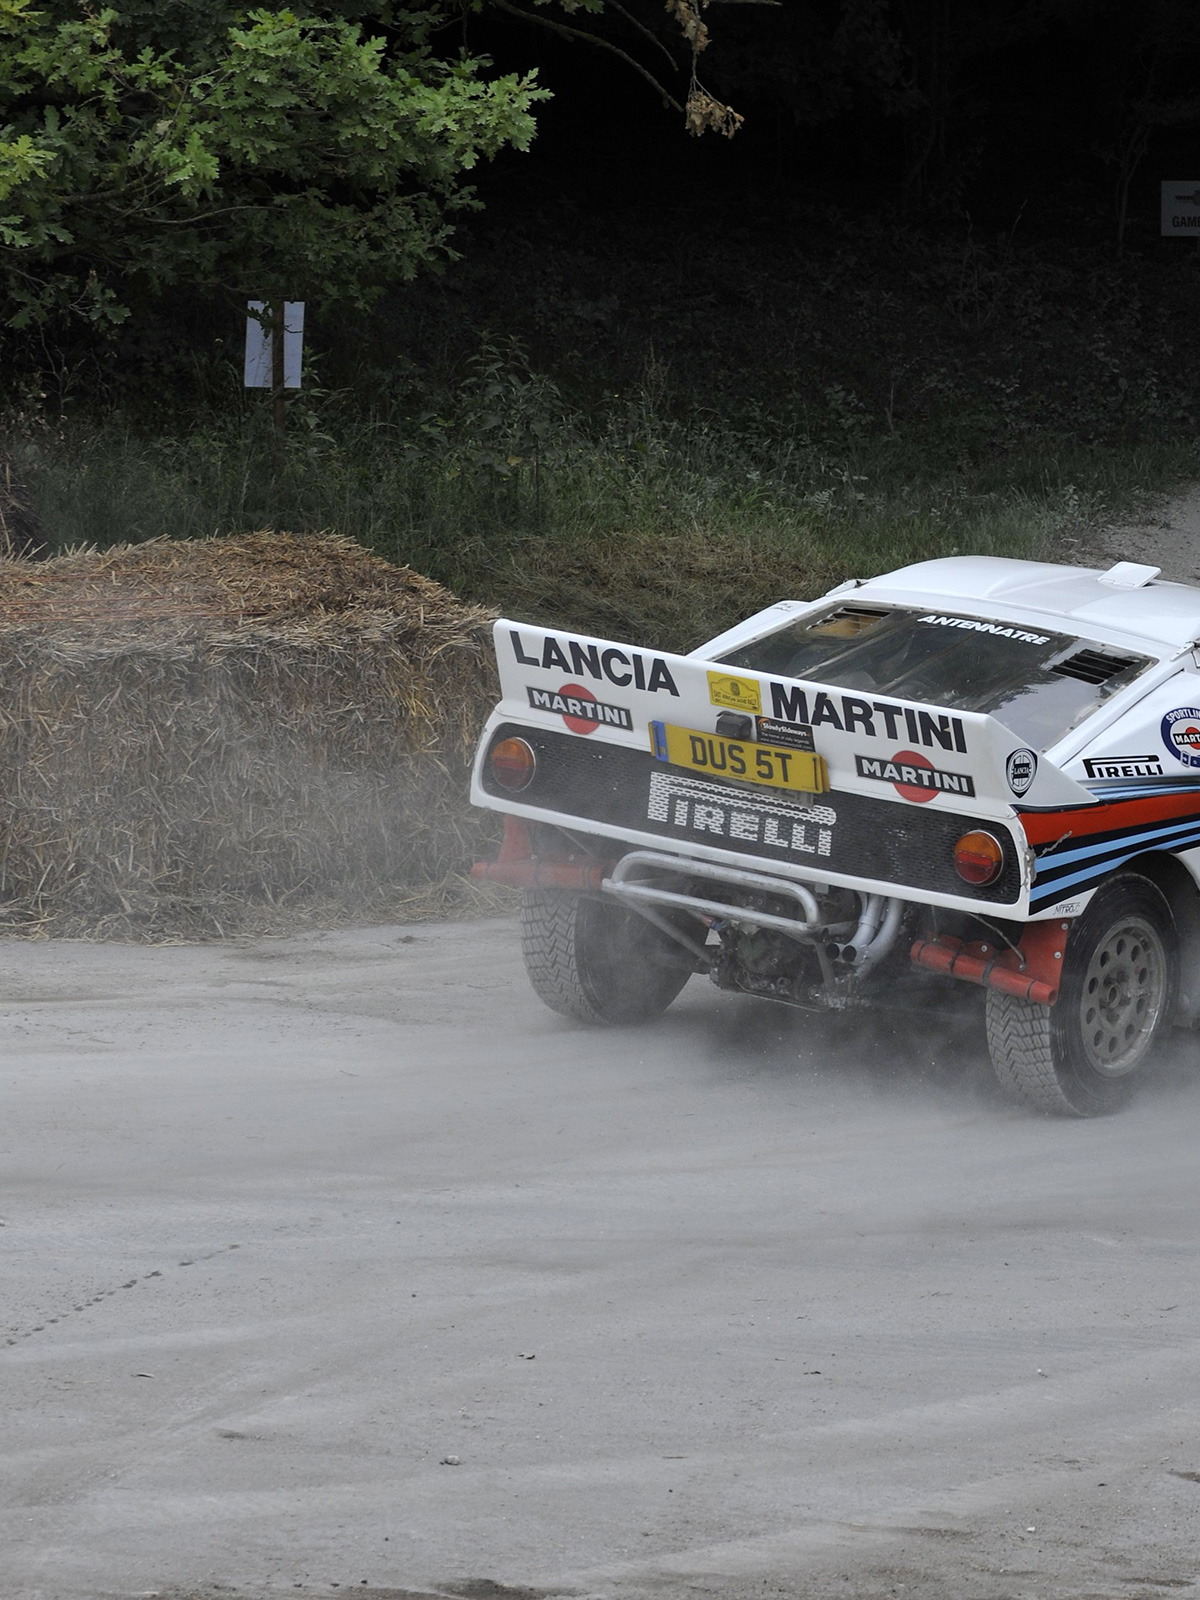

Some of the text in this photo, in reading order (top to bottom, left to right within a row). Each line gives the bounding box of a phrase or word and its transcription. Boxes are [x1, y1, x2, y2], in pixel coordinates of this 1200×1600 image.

[917, 615, 1050, 646] ANTENNATRE
[510, 630, 680, 697] LANCIA
[533, 690, 627, 727] MARTINI
[770, 682, 967, 753] MARTINI
[689, 735, 793, 782] DUS 5T
[861, 758, 969, 793] MARTINI
[1083, 755, 1164, 779] PIRELLI
[648, 771, 837, 857] PIRELLI
